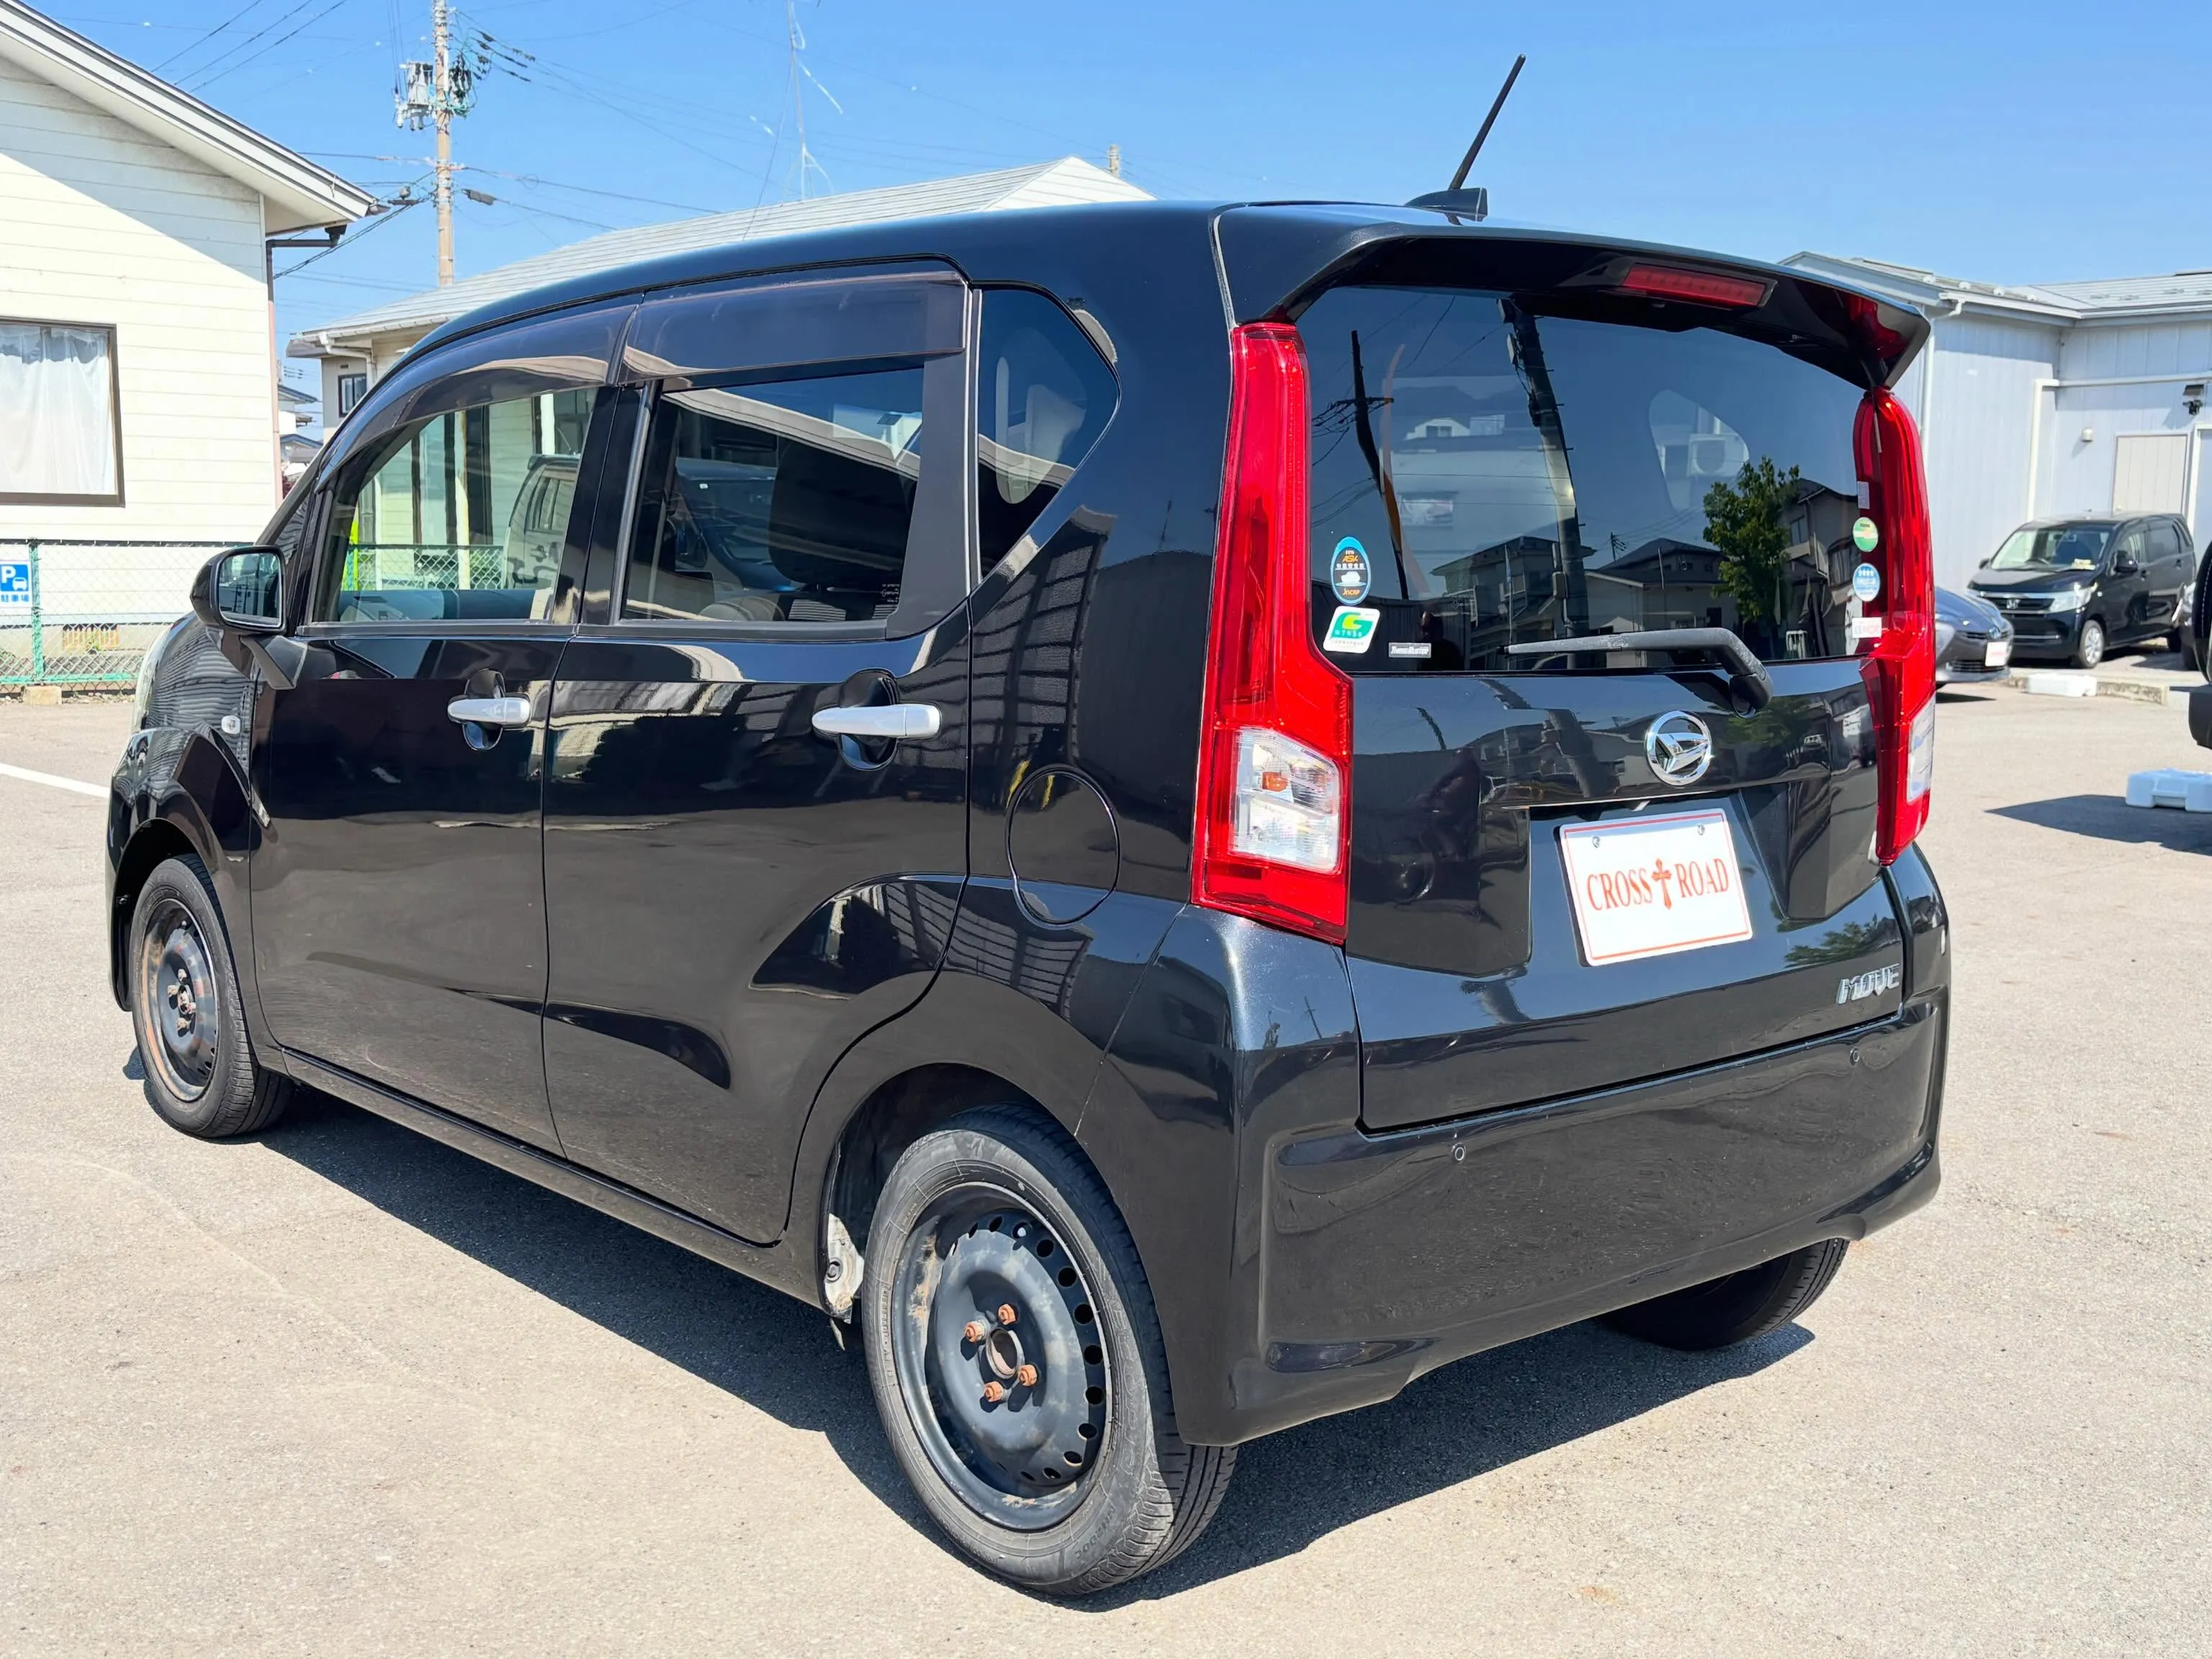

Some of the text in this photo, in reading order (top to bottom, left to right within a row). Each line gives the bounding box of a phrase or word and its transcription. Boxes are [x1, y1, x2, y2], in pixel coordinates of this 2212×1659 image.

[1, 566, 16, 583] P
[1587, 858, 1729, 911] CROSS ROAD
[1836, 963, 1899, 1004] MOVE
